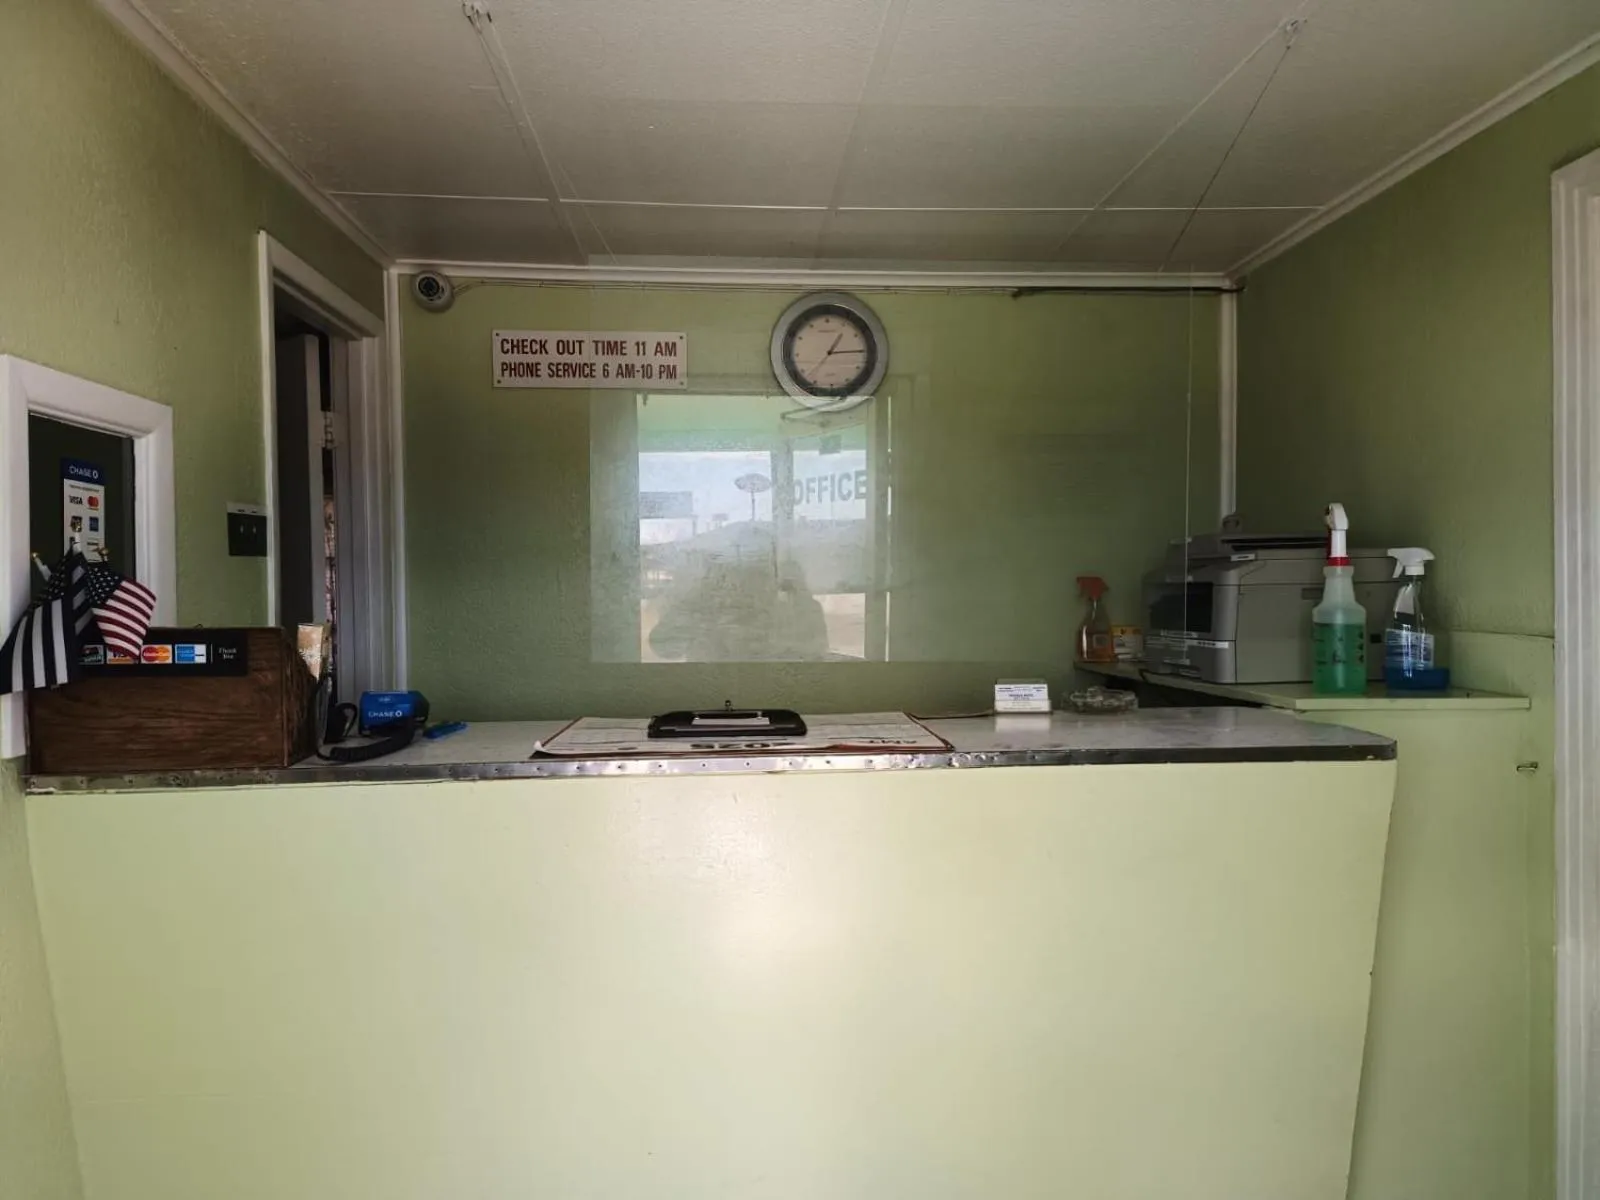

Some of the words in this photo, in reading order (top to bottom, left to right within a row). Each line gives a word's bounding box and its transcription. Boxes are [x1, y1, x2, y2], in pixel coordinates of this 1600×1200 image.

[500, 338, 549, 355] CHECK
[556, 339, 585, 356] OUT
[592, 339, 628, 356] TIME
[635, 341, 646, 356] 11
[654, 341, 677, 357] AM
[501, 361, 542, 378] PHONE
[547, 362, 597, 378] SERVICE
[602, 363, 610, 378] 6
[615, 363, 653, 379] AM-10
[658, 364, 677, 379] PM
[792, 469, 867, 507] OFFICE
